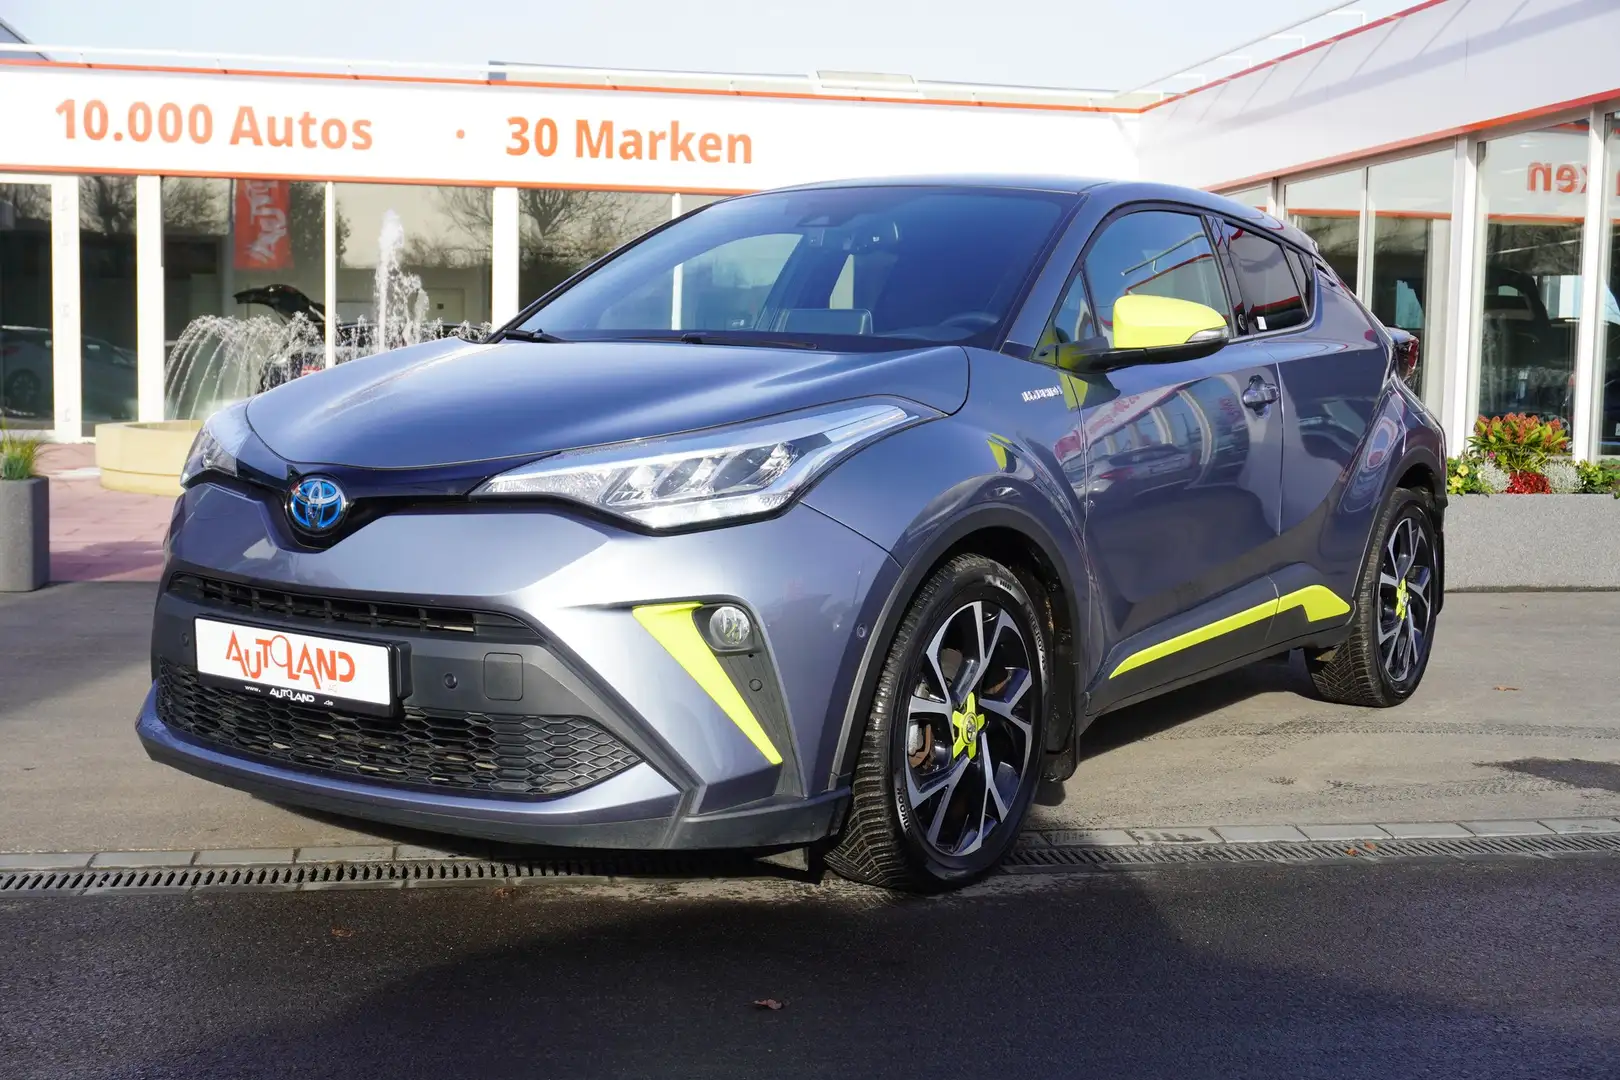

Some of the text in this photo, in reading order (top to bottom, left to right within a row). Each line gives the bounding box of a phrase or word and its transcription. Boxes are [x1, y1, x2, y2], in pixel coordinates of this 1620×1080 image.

[55, 99, 752, 164] 10.000 Autos 30 Marken
[226, 630, 356, 690] AUTOLAND
[269, 687, 315, 703] AUTOLAND
